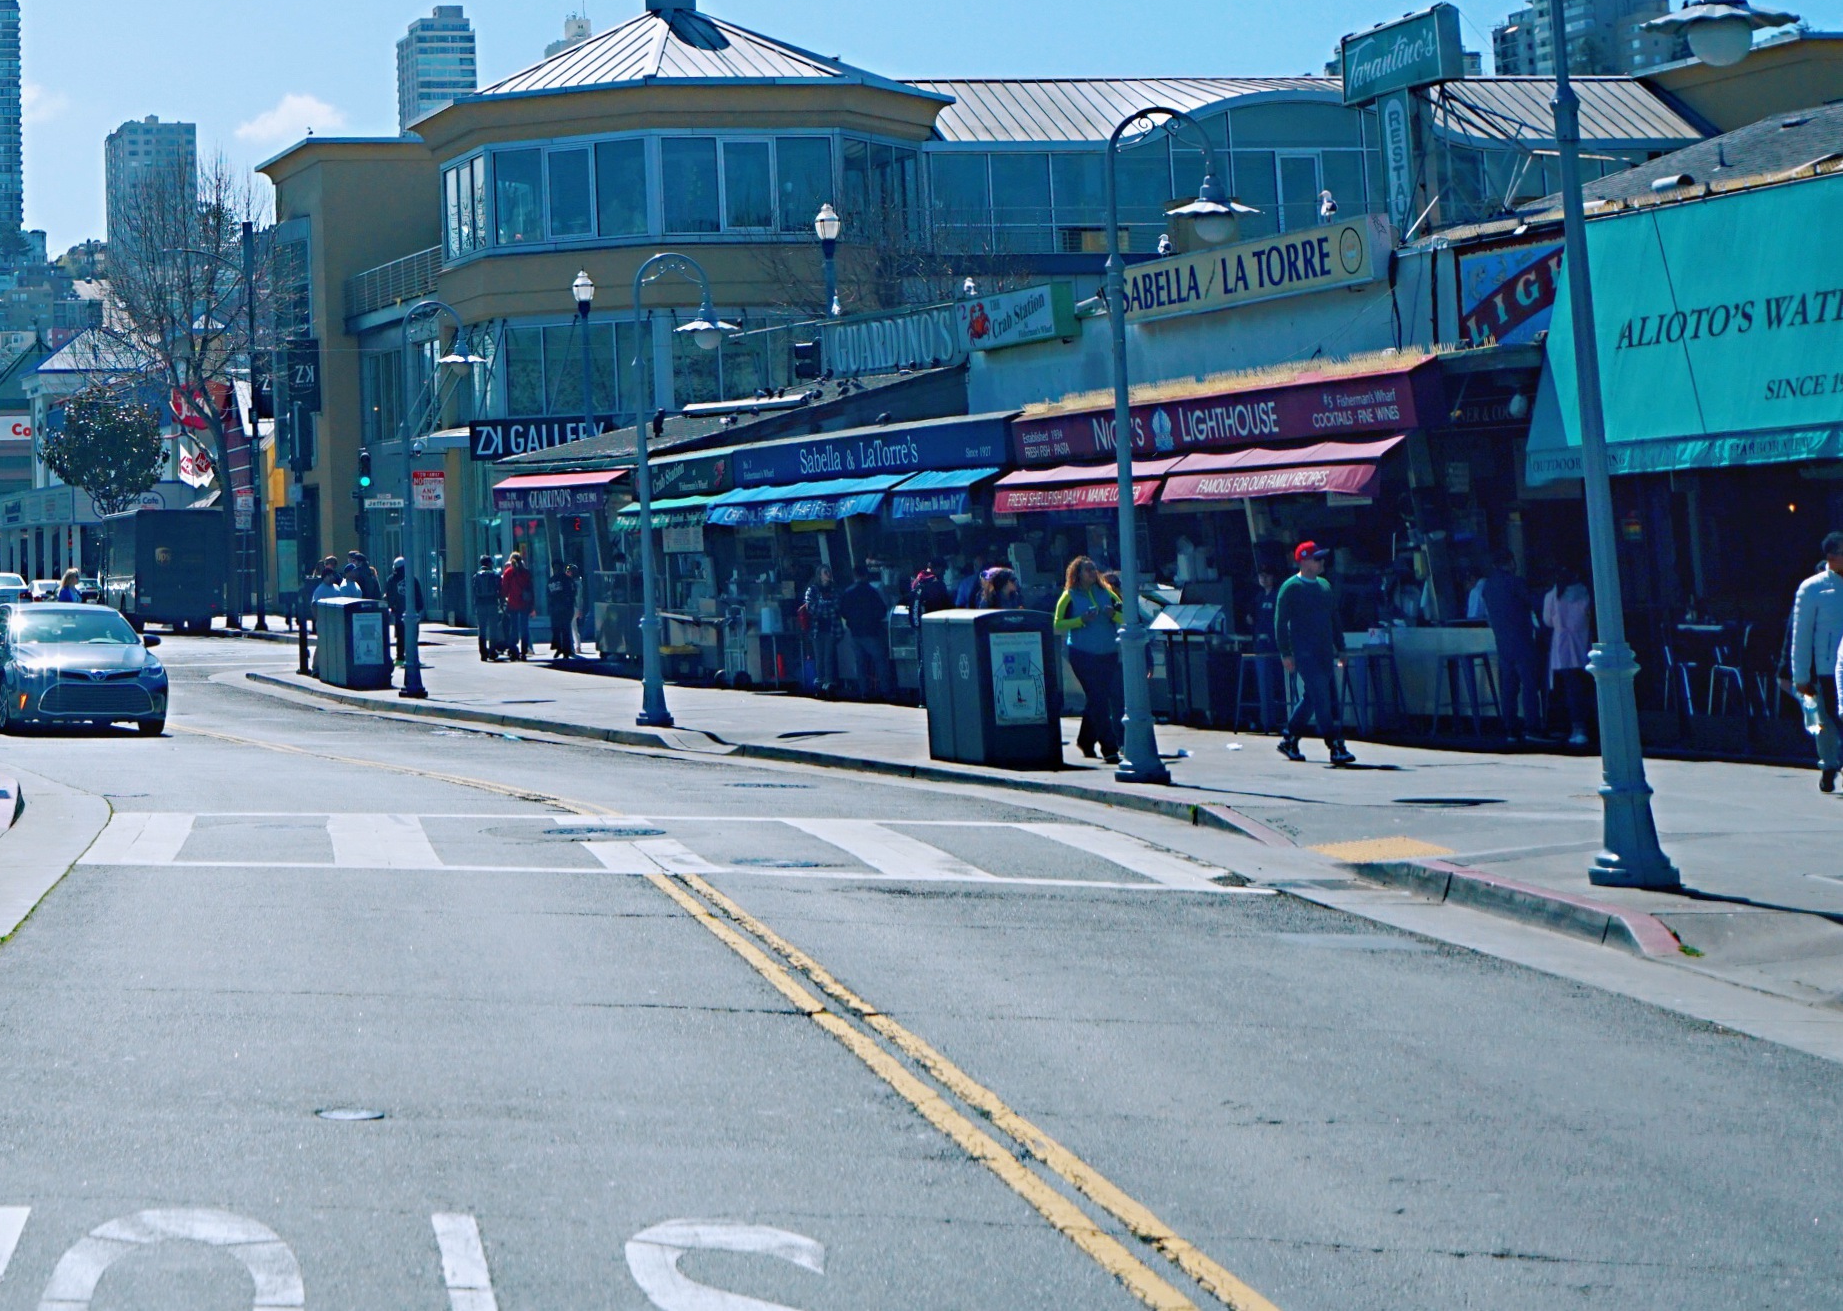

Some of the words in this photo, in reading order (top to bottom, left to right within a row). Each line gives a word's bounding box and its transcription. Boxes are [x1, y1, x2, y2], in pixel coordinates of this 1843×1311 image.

[1345, 28, 1437, 97] Tarantino's
[1221, 255, 1249, 295] LA
[1252, 236, 1332, 289] TORRE
[992, 310, 1013, 339] Crab
[1013, 292, 1046, 325] Station
[1615, 300, 1756, 351] ALIOTO'S
[835, 309, 954, 372] GUARDINO'S
[1336, 390, 1375, 407] Fisherman's
[1374, 388, 1397, 402] Wharf
[1765, 374, 1827, 401] SINCE
[1178, 401, 1280, 442] LIGHTHOUSE
[1312, 411, 1353, 428] COCKTAILS
[1357, 409, 1374, 424] FINE
[1376, 405, 1400, 421] WINES
[799, 445, 841, 475] Sabella
[846, 453, 856, 470] &
[859, 435, 919, 469] LaTorre's
[965, 447, 979, 458] Since
[1007, 493, 1027, 507] FRESH
[1027, 491, 1063, 506] SHELLFISH
[1062, 489, 1082, 504] DAILY
[1086, 488, 1110, 502] MAINE
[1109, 485, 1142, 502] LOER
[1195, 476, 1232, 493] FAMOUS
[1233, 477, 1248, 492] FOR
[1248, 475, 1267, 491] OUR
[1266, 472, 1296, 490] FAMILY
[1293, 470, 1330, 488] RECIPES
